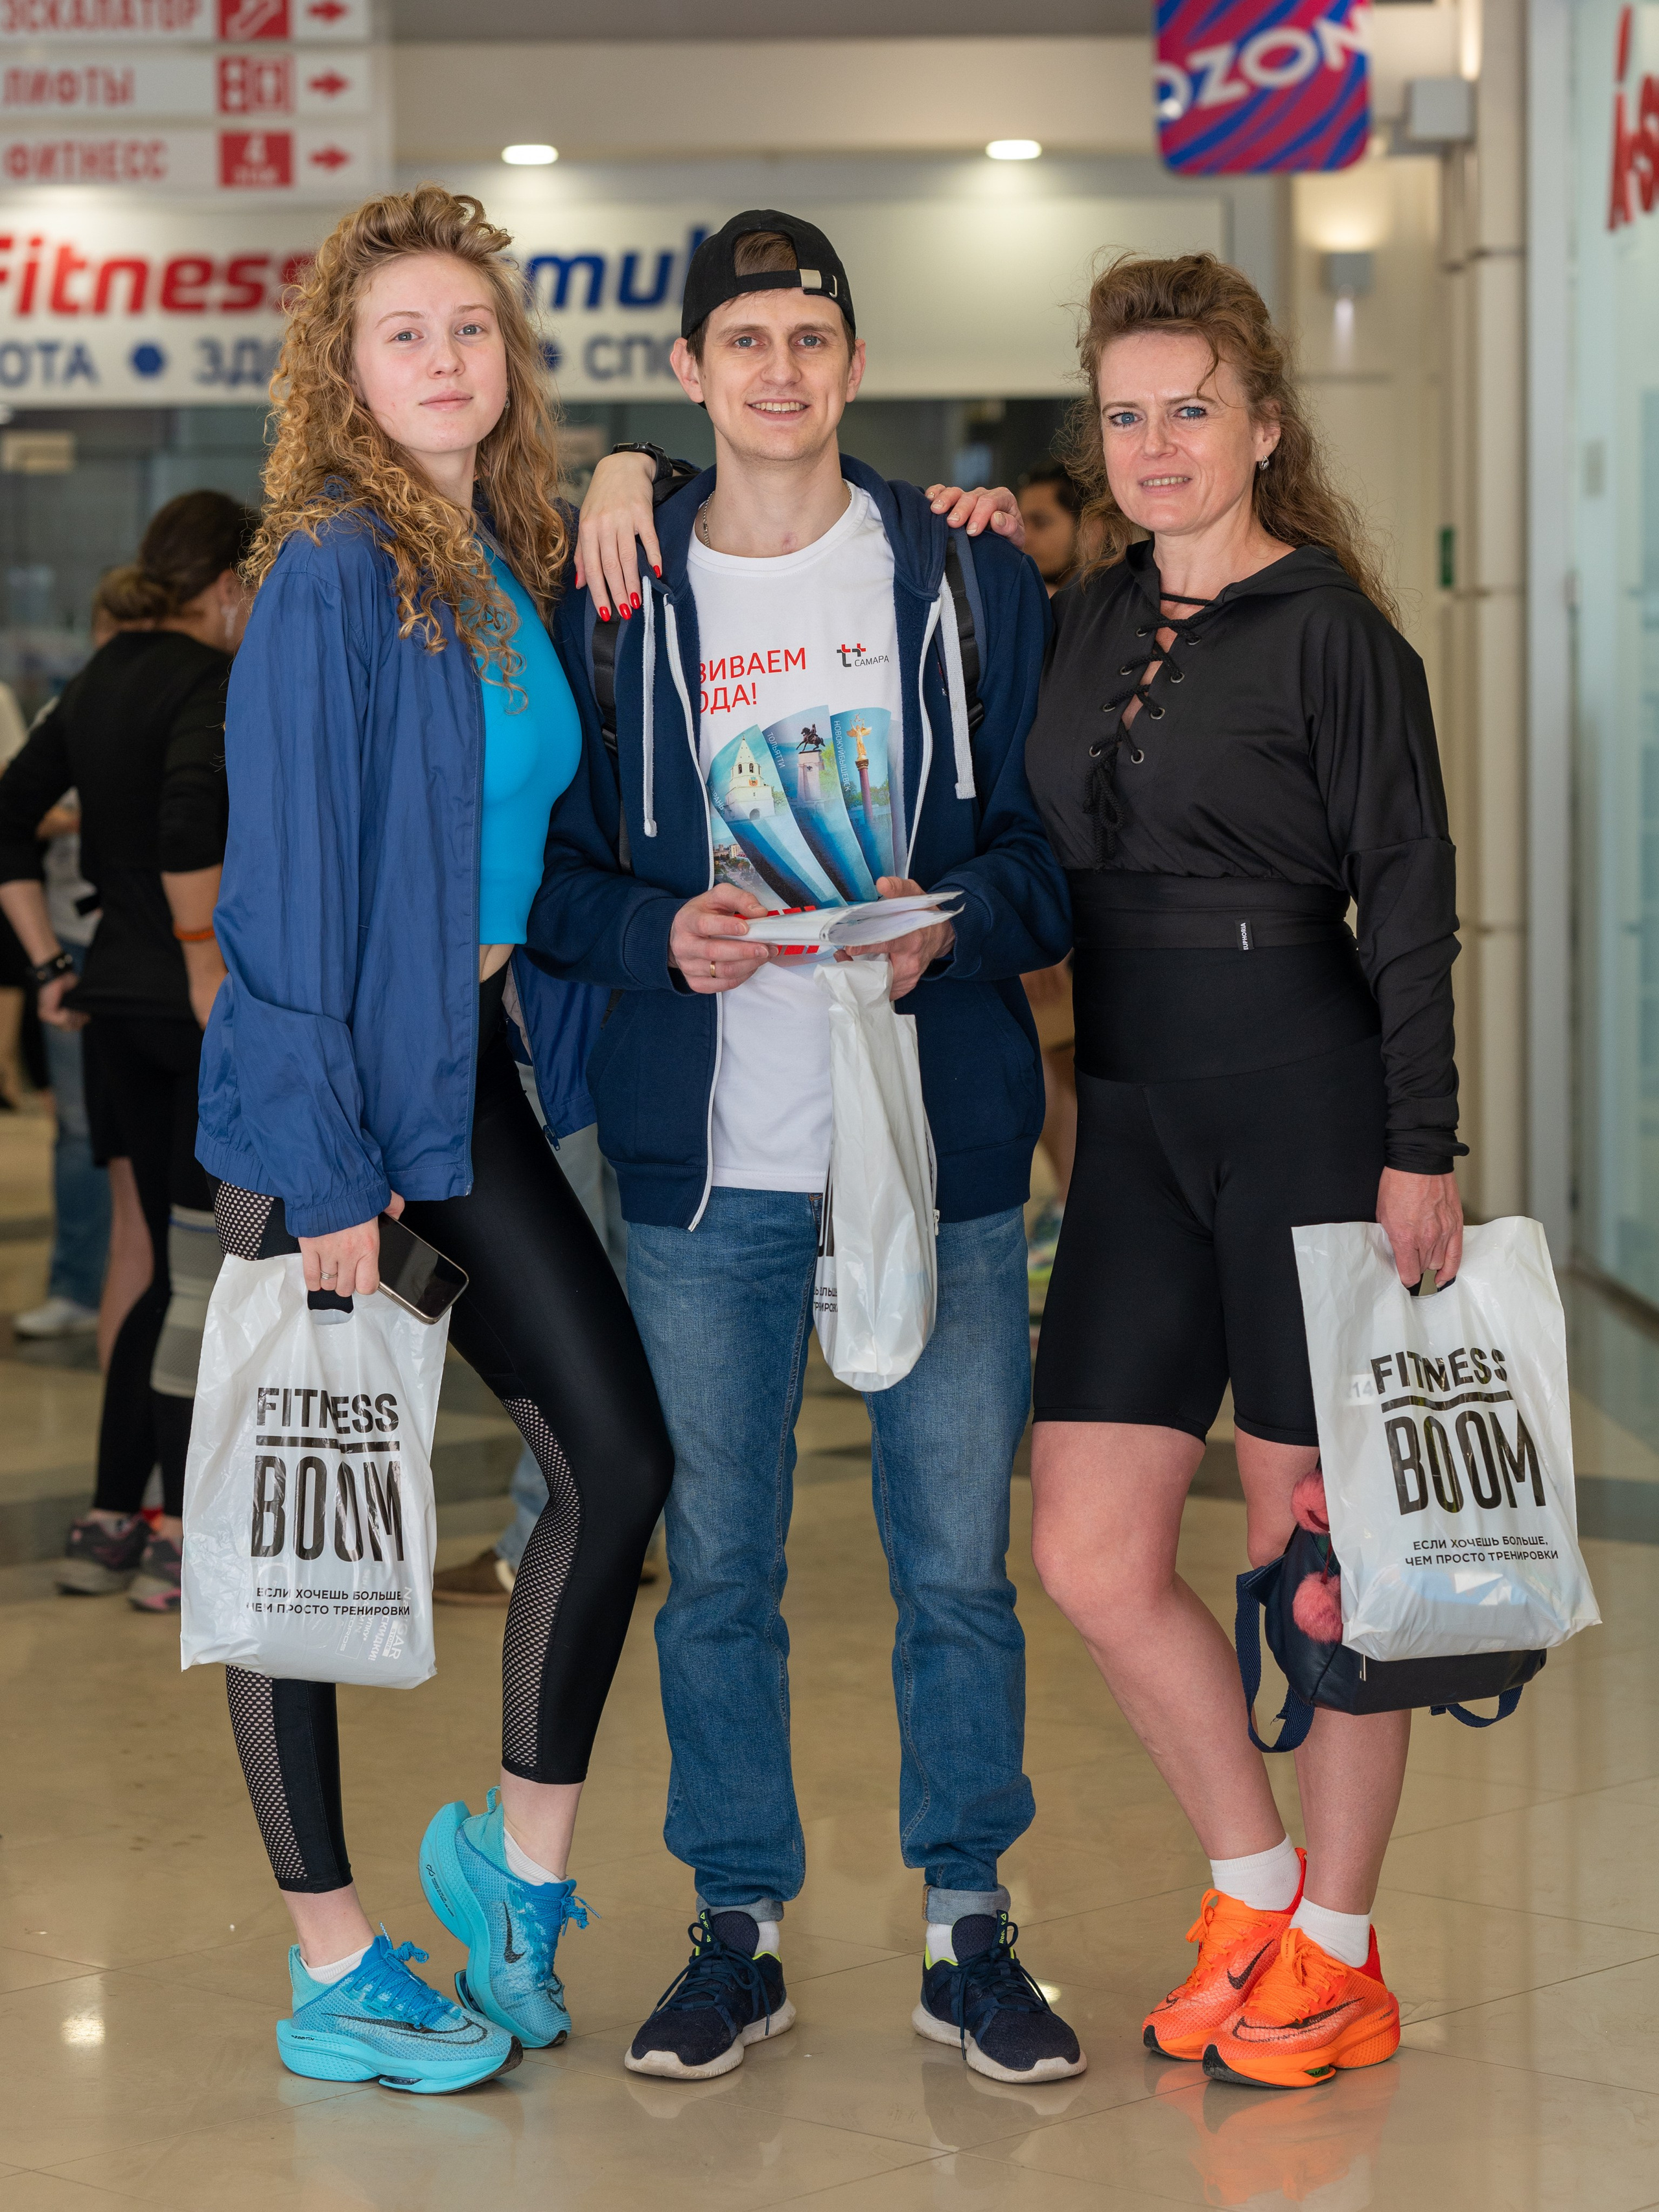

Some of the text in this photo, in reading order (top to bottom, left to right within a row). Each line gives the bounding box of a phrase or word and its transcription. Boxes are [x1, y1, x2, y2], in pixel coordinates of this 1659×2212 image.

[4, 67, 134, 106] ЛИФТЫ
[5, 140, 167, 180] ФИТНЕСС
[854, 655, 890, 667] САМАРА
[767, 732, 785, 768] ТОЛЬЯТТИ
[833, 720, 851, 792] НОВОКУЙБЫШЕВСК
[1240, 922, 1249, 950] EUPHORIA
[1371, 1347, 1508, 1395] FITNESS
[257, 1388, 399, 1434] FITNESS
[1384, 1409, 1546, 1515] BOOM
[251, 1456, 404, 1562] BOOM
[1405, 1550, 1559, 1566] ЧЕМ ПРОСТО ТРЕНИРОВКИ
[1413, 1536, 1548, 1550] ЕСЛИ ХОЧЕШЬ БОЛЬШЕ,
[257, 1587, 291, 1598] ЕСЛИ
[296, 1589, 349, 1600] ХОЧЕШЬ
[277, 1603, 329, 1614] ПРОСТО
[333, 1605, 410, 1616] ТРЕНИРОВКИ
[703, 1920, 712, 1942] Reok
